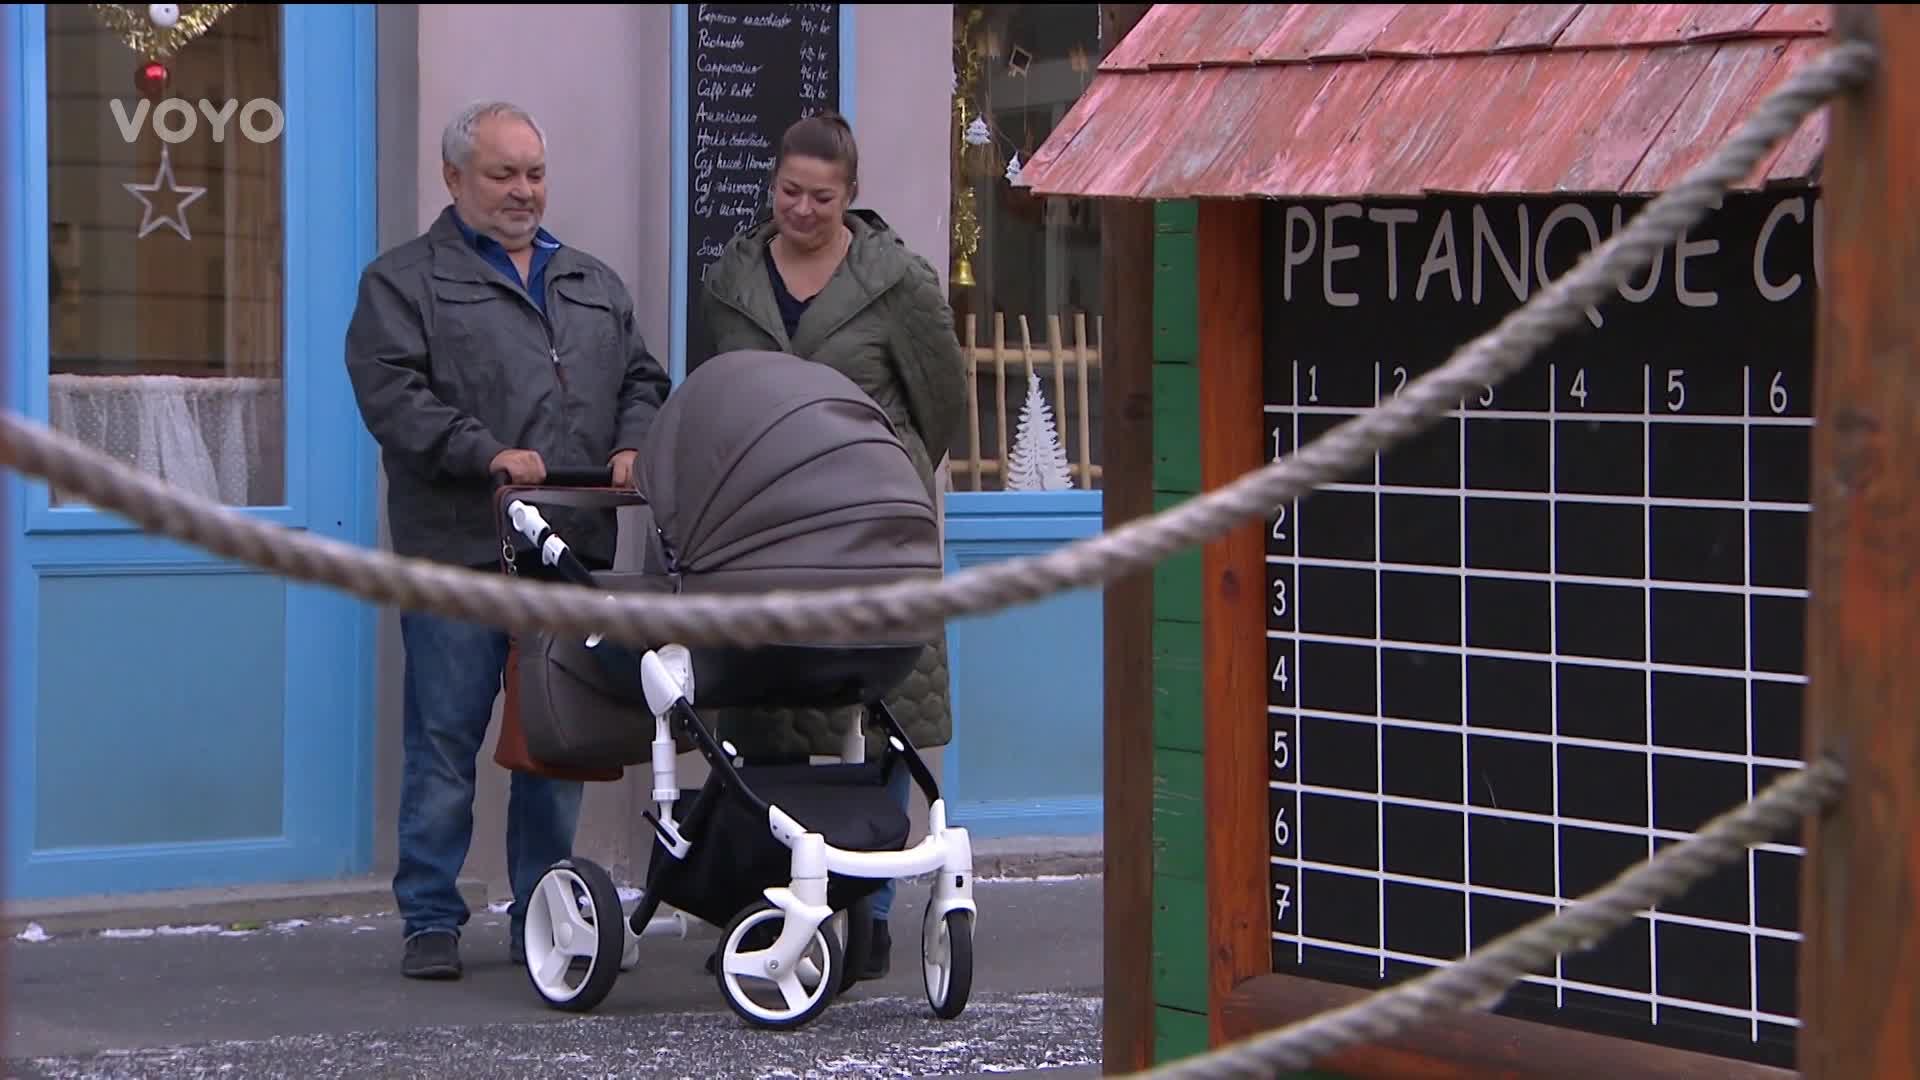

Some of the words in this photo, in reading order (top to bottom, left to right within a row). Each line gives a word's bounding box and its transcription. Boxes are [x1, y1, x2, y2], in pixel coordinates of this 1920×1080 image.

[1283, 203, 1721, 328] PETANQUE
[1753, 197, 1822, 302] C
[1307, 364, 1319, 402] 1
[1570, 368, 1588, 408] 4
[1667, 369, 1685, 412] 5
[1769, 371, 1788, 414] 6
[1271, 426, 1282, 464] 1
[1271, 503, 1287, 541] 2
[1272, 579, 1287, 617] 3
[1272, 655, 1289, 693] 4
[1273, 731, 1289, 769] 5
[1274, 807, 1290, 845] 6
[1274, 883, 1292, 922] 7
